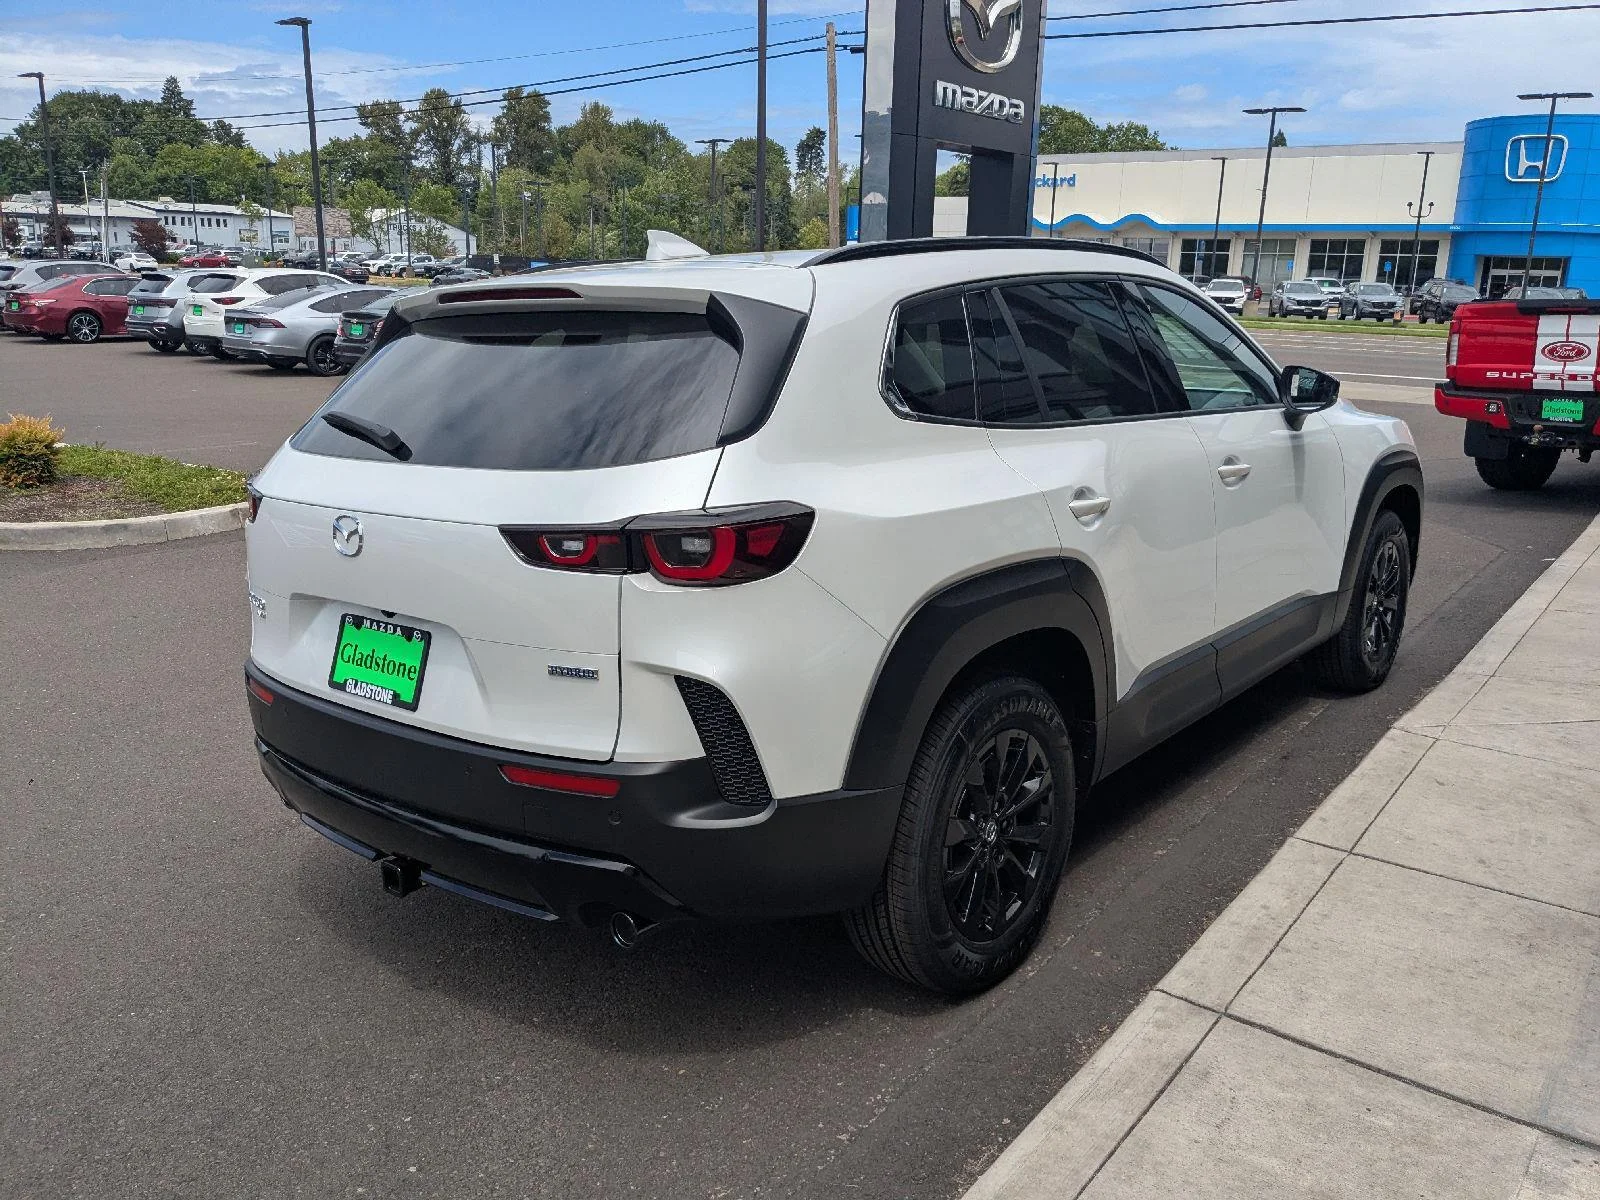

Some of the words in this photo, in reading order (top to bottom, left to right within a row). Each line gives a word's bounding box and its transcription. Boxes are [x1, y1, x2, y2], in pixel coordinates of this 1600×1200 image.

[1552, 346, 1578, 358] Ford
[1485, 371, 1569, 381] SUPER
[1543, 405, 1582, 415] Gladstone
[362, 618, 402, 636] MAZDA
[340, 642, 417, 681] Gladstone
[550, 665, 595, 679] HYBRID
[346, 678, 394, 705] GLADSTONE
